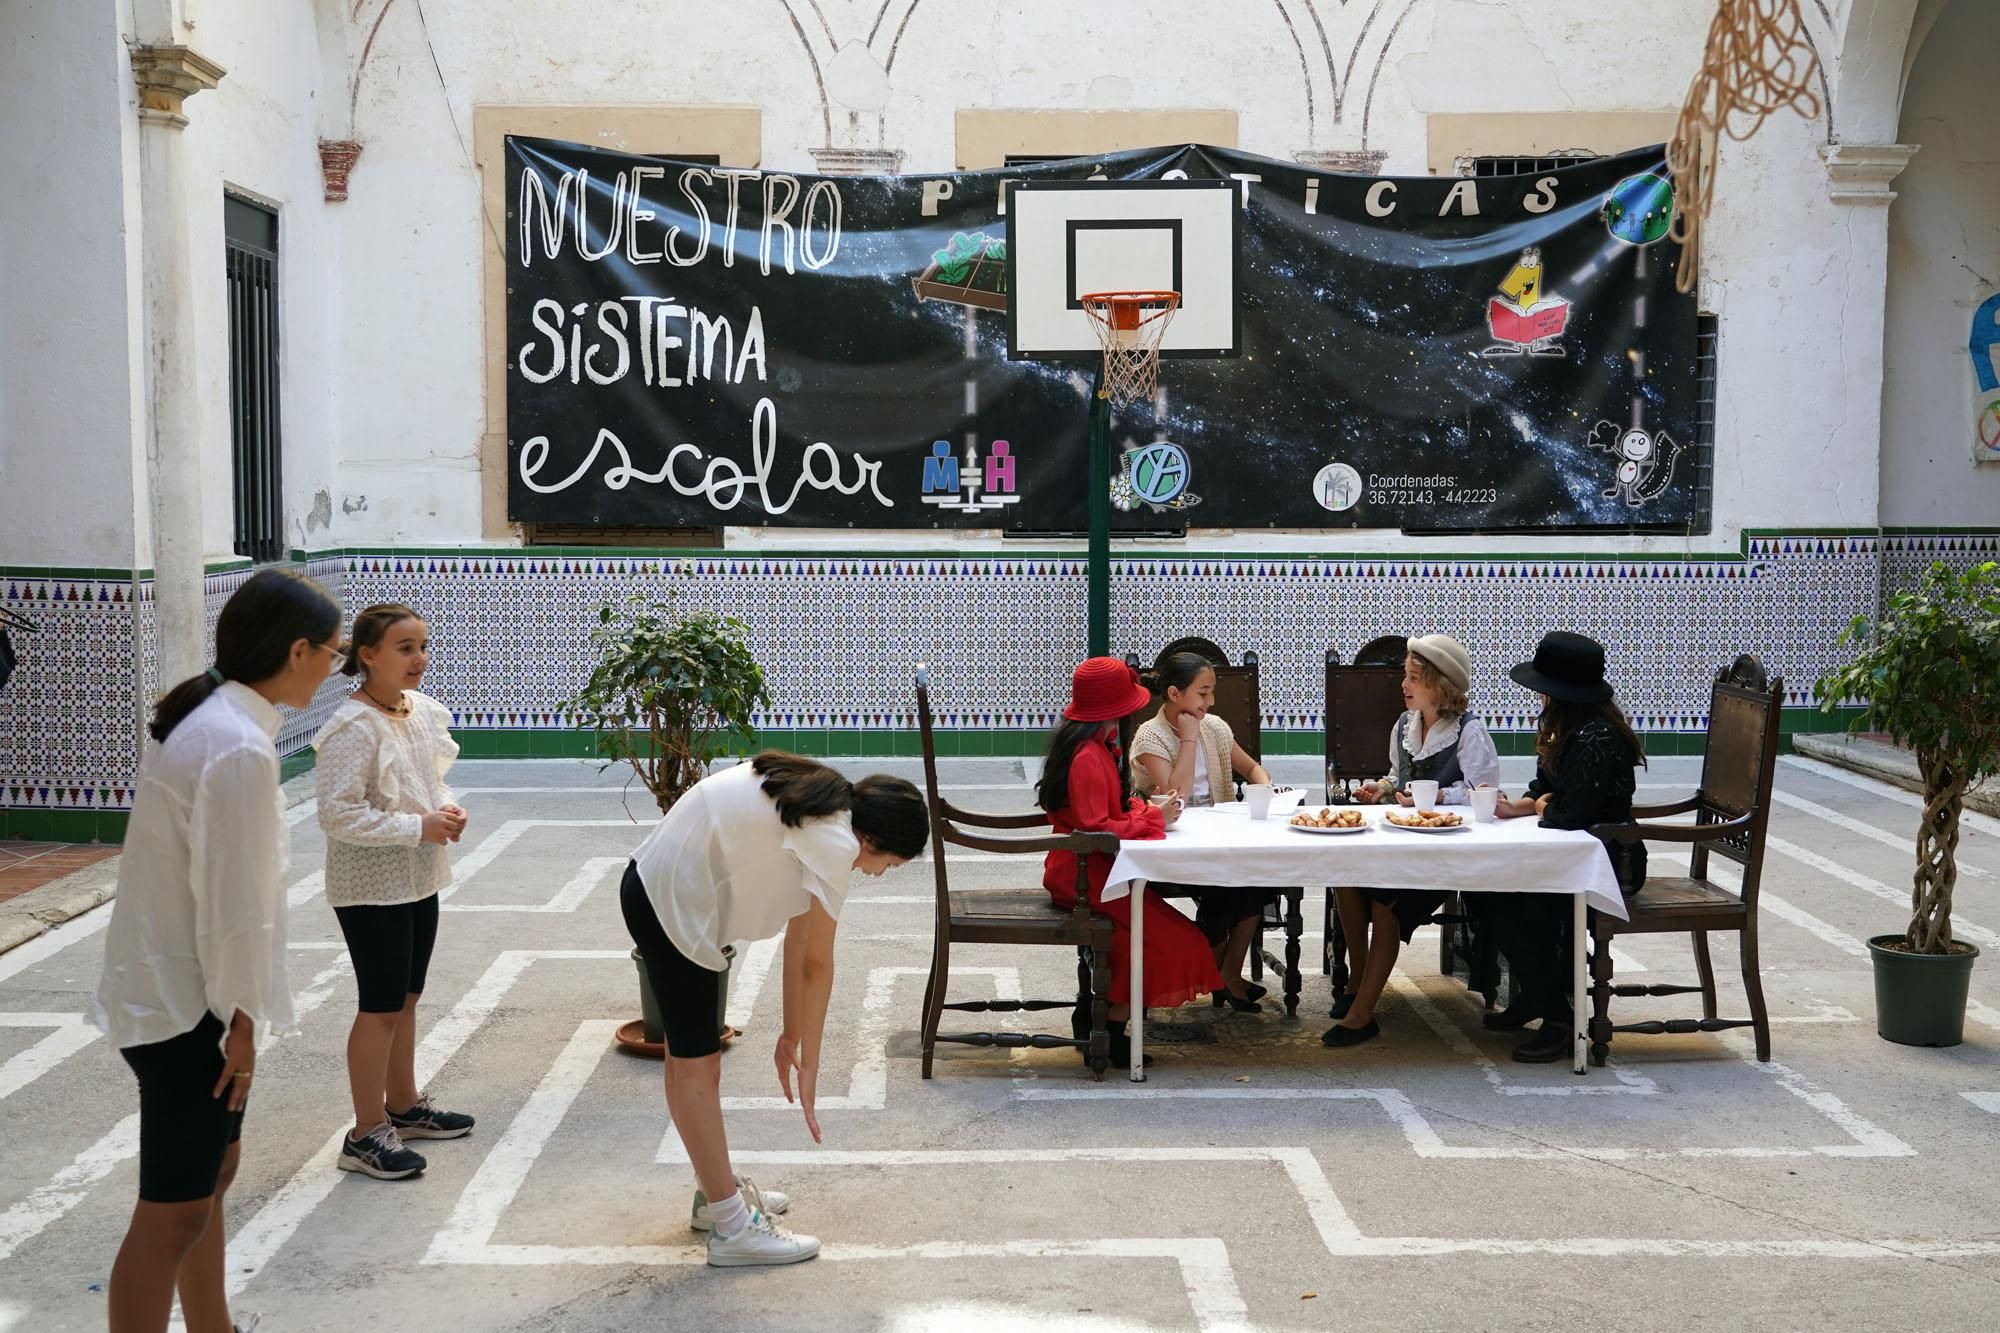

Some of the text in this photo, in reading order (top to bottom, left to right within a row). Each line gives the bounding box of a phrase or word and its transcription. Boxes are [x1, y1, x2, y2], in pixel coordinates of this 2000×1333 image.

[519, 166, 842, 276] NUESTRO
[519, 397, 895, 515] escolar
[1369, 473, 1459, 489] Coordenadas:
[1369, 488, 1498, 506] 36.72143, -442223
